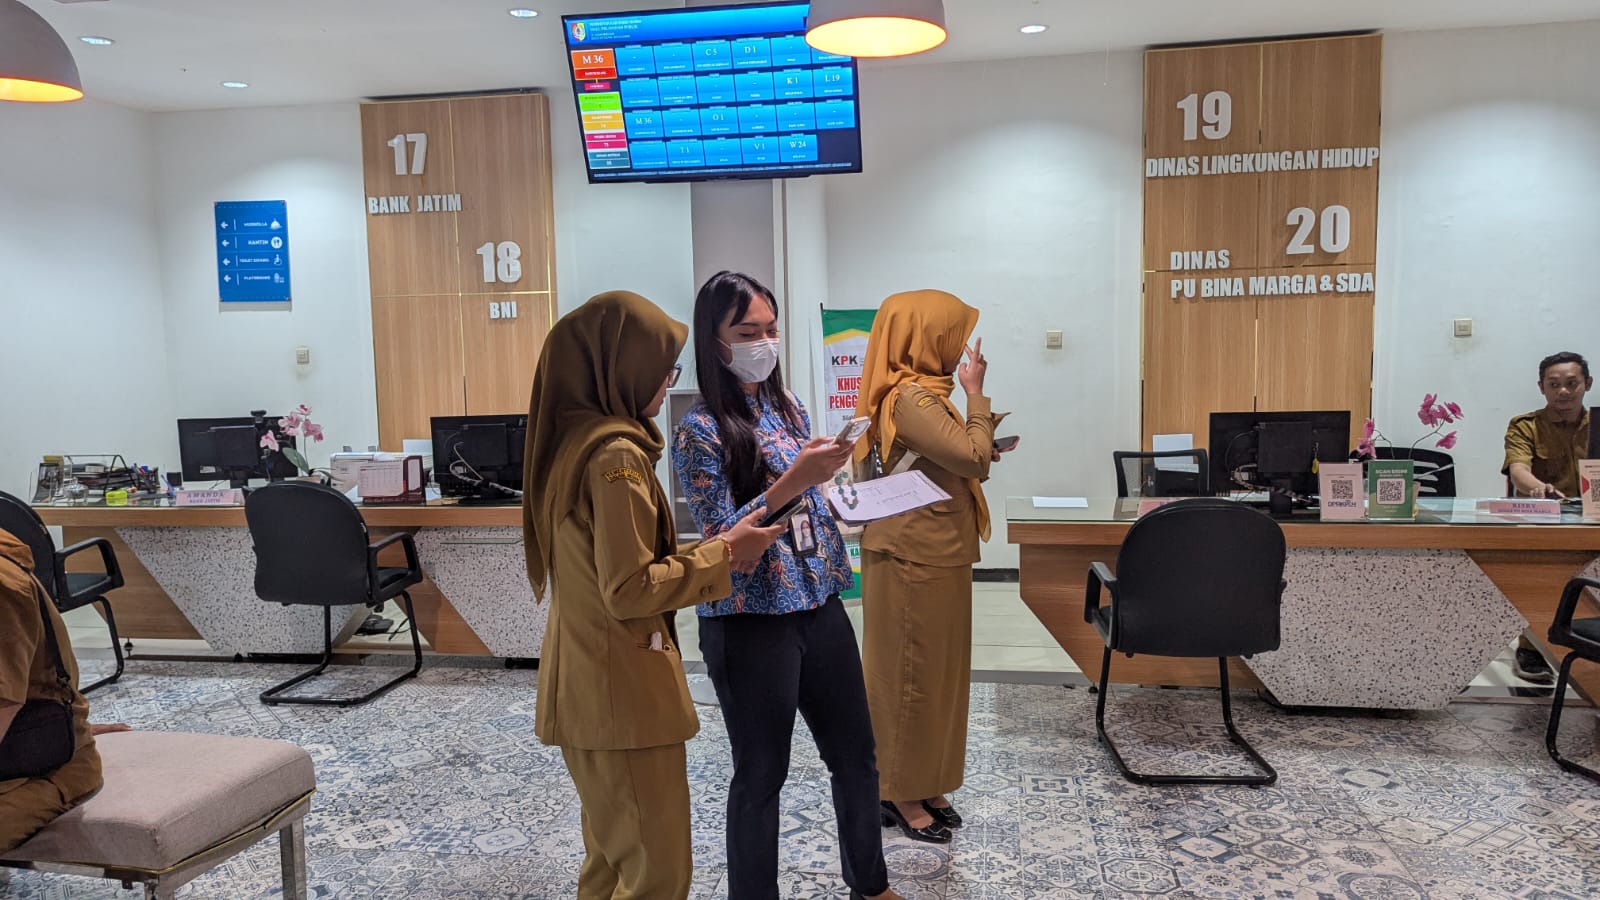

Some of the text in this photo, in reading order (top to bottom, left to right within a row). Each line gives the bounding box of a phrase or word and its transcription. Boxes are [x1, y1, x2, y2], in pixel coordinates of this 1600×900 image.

[582, 54, 604, 64] M 36
[1176, 90, 1232, 141] 19
[387, 132, 428, 176] 17
[1146, 147, 1380, 178] DINAS LINGKUNGAN HIDUP
[368, 194, 462, 214] BANK JATIM
[1286, 204, 1350, 255] 20
[476, 240, 522, 284] 18
[1170, 250, 1230, 270] DINAS
[1170, 272, 1374, 298] PU BINA MARGA & SDA
[489, 301, 518, 319] BNI
[832, 355, 858, 366] KPK
[838, 376, 862, 391] KHUS
